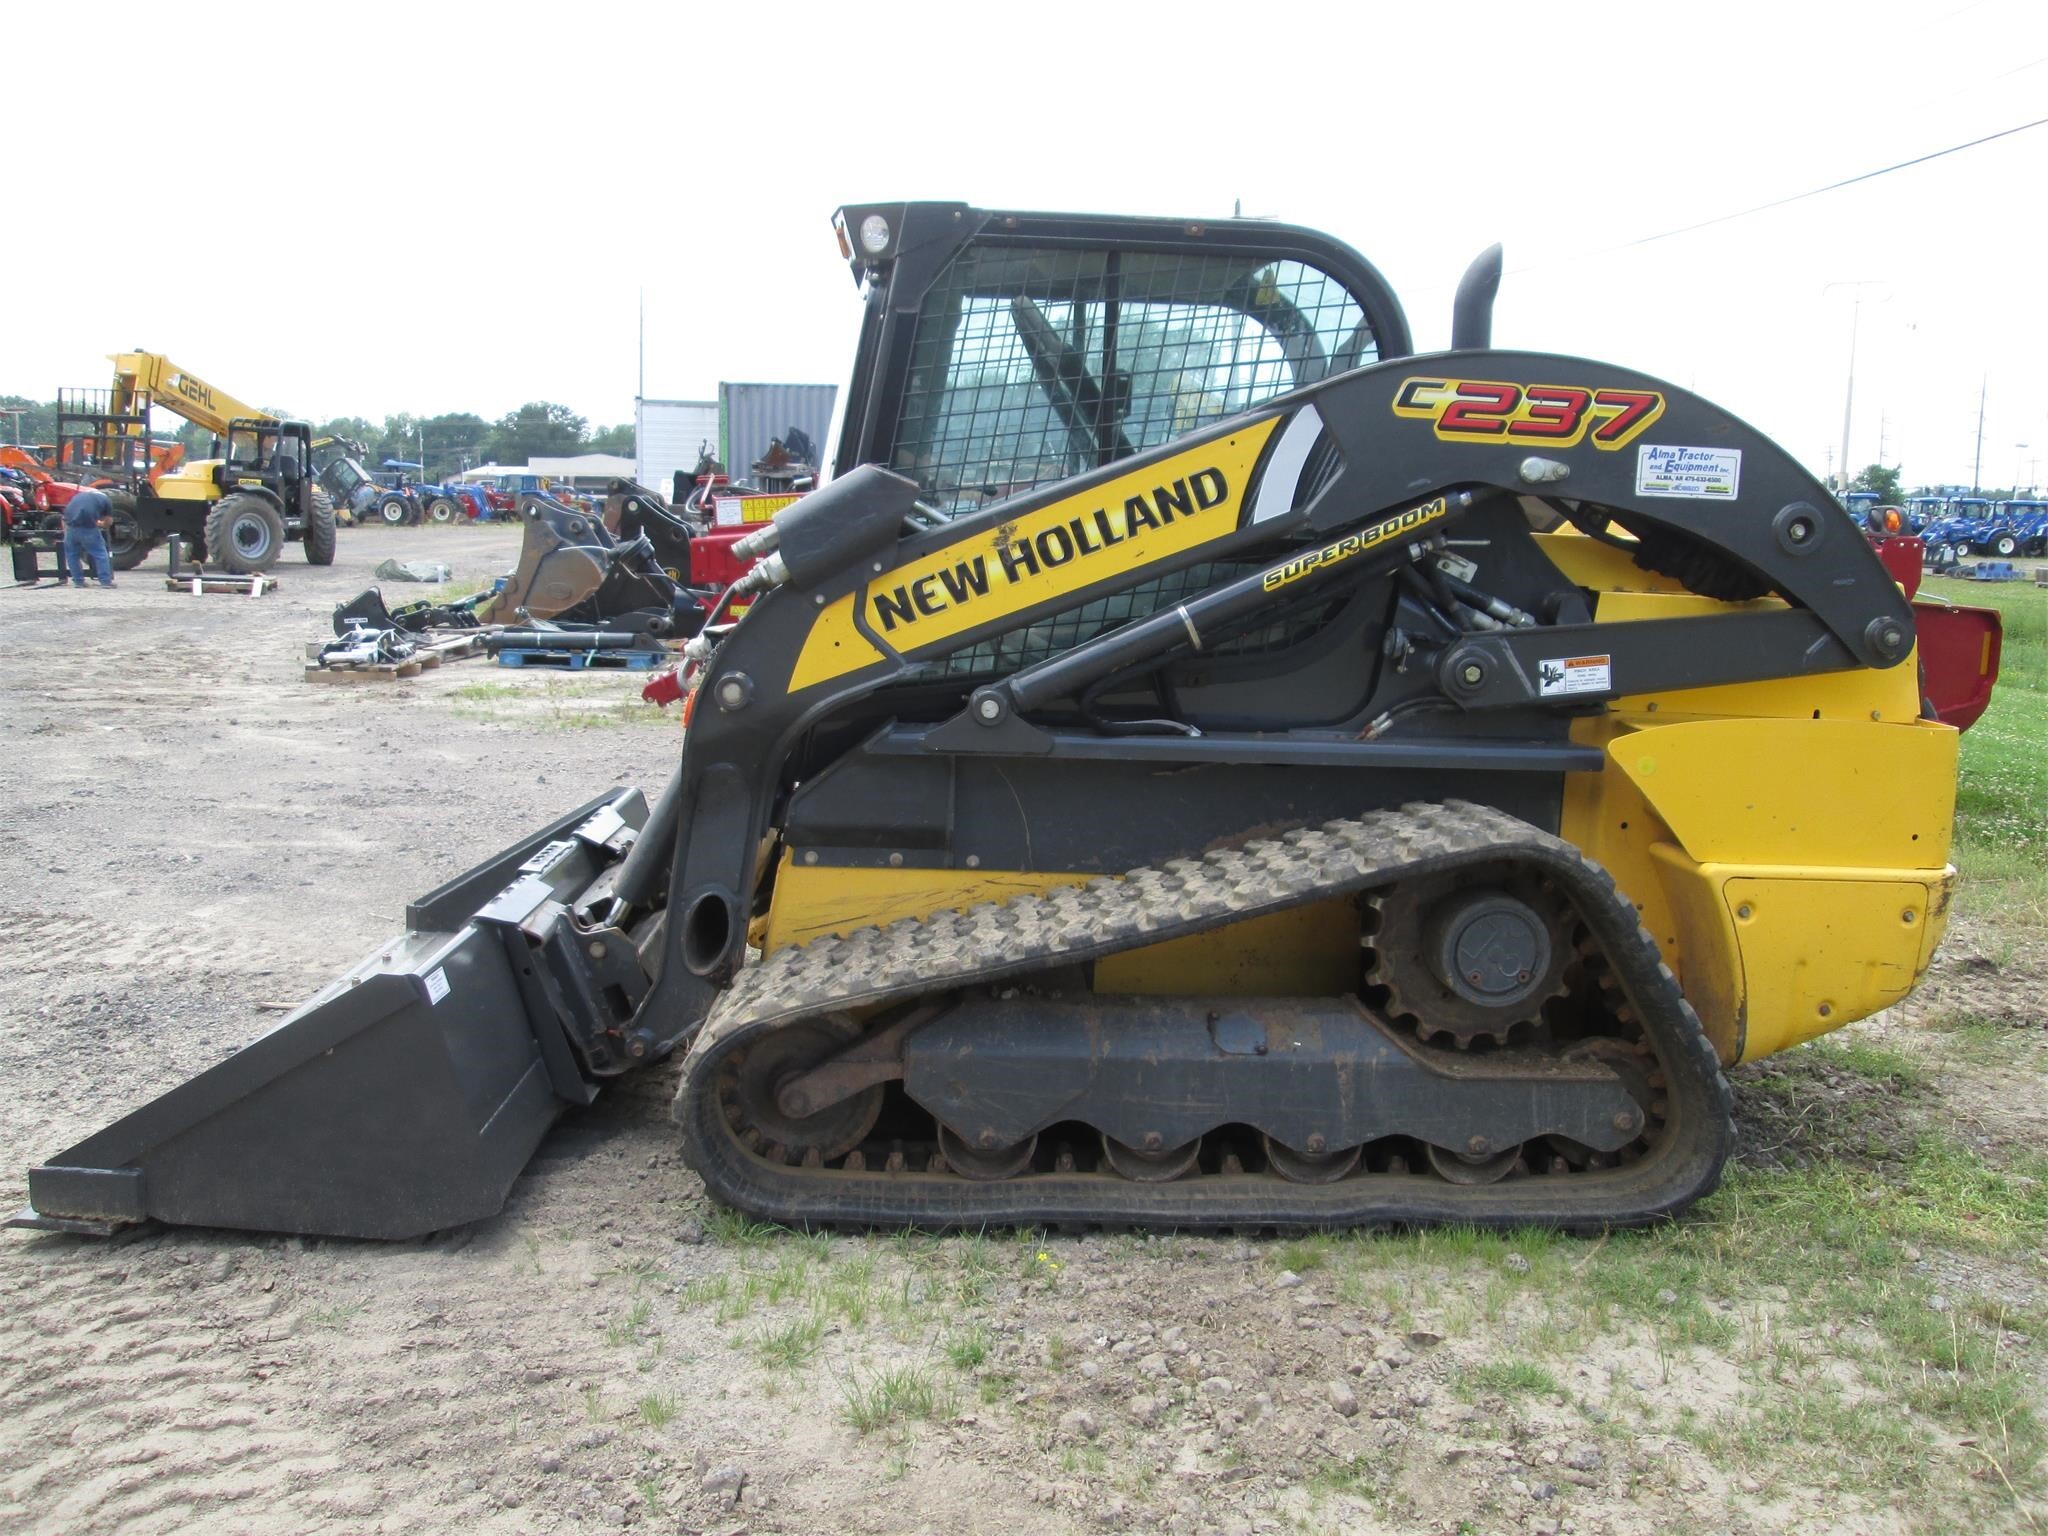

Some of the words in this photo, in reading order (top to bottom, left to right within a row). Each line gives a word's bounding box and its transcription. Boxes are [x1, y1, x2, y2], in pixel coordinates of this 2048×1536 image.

[178, 374, 216, 411] GEHL
[1394, 378, 1665, 449] C237
[1648, 447, 1675, 460] Alma
[1678, 448, 1714, 461] Tractor
[1664, 460, 1719, 473] Equipment
[873, 555, 990, 632] NEW
[1000, 467, 1229, 584] HOLLAND
[1264, 534, 1360, 591] SUPER
[1361, 498, 1446, 549] BOOM
